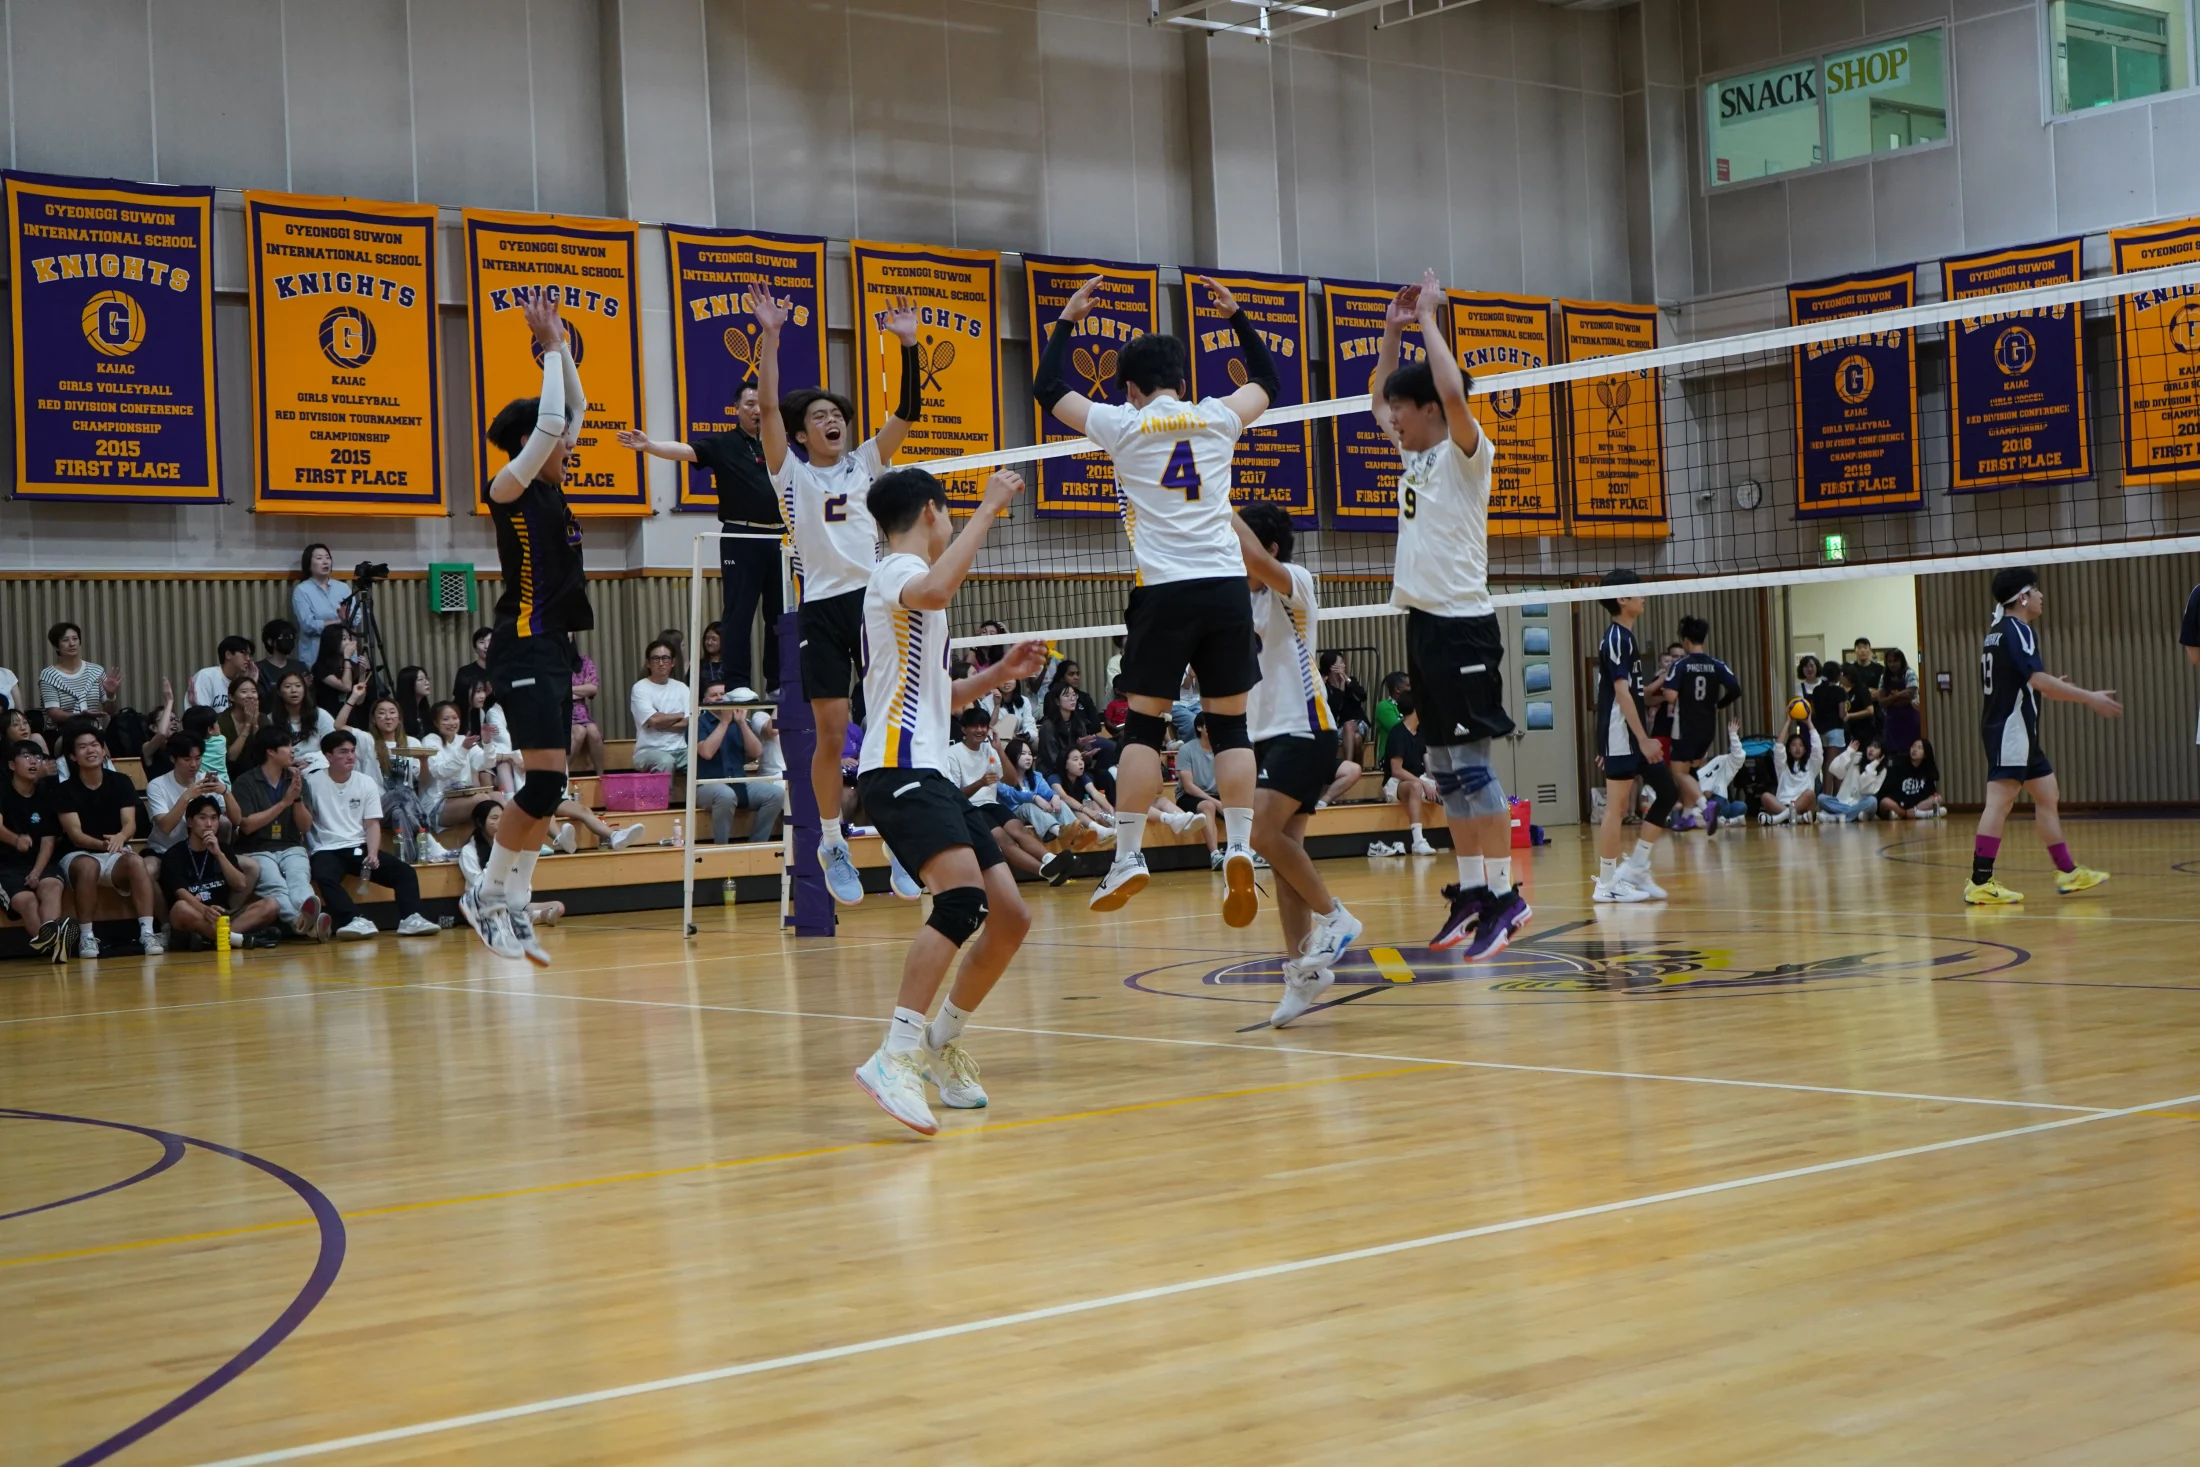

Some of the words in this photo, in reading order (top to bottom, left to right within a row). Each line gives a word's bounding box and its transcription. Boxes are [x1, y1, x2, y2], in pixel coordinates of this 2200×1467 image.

[1721, 69, 1816, 119] SNACK
[1827, 47, 1908, 94] SHOP
[45, 204, 117, 220] GYEONGGI
[121, 210, 175, 225] SUWON
[24, 224, 141, 245] INTERNATIONAL
[145, 234, 196, 248] SCHOOL
[286, 224, 350, 239] GYEONGGI
[354, 230, 402, 244] SUWON
[266, 243, 372, 263] INTERNATIONAL
[375, 254, 422, 266] SCHOOL
[499, 240, 558, 253] GYEONGGI
[561, 245, 606, 257] SUWON
[2141, 243, 2193, 259] GYEONGGI
[699, 252, 753, 264] GYEONGGI
[756, 254, 797, 269] SUWON
[32, 254, 190, 292] KNIGHTS
[482, 259, 579, 276] INTERNATIONAL
[581, 267, 624, 278] SCHOOL
[882, 266, 932, 278] GYEONGGI
[934, 270, 971, 283] SUWON
[1969, 265, 2016, 283] GYEONGGI
[2018, 260, 2055, 274] SUWON
[683, 269, 772, 286] INTERNATIONAL
[774, 277, 813, 288] SCHOOL
[274, 272, 416, 308] KNIGHTS
[867, 283, 948, 299] INTERNATIONAL
[951, 290, 986, 301] SCHOOL
[1100, 281, 1134, 294] SUWON
[1957, 281, 2032, 299] INTERNATIONAL
[2035, 274, 2070, 288] SCHOOL
[1208, 291, 1250, 302] GYNGGI
[1252, 293, 1284, 306] SUWON
[1812, 295, 1855, 311] GYEONGGI
[1856, 290, 1891, 304] SUWON
[689, 293, 809, 327] KNIGTS
[1115, 301, 1148, 312] SCHOOL
[1346, 301, 1386, 313] GYEONGGI
[98, 301, 130, 345] G
[874, 306, 982, 338] KGHTS
[1267, 312, 1297, 323] SCHOOL
[1468, 312, 1505, 322] GYEONGGI
[1506, 313, 1533, 325] SUWON
[1458, 327, 1517, 339] INTERNATIONAL
[1519, 331, 1544, 341] SCHOOL
[1580, 320, 1613, 330] GYEONGGI
[1616, 322, 1640, 333] SUWON
[333, 317, 363, 359] G
[1571, 336, 1625, 348] INTERNATIONAL
[1627, 339, 1651, 349] SCHOOL
[1464, 346, 1542, 369] KNIGHTS
[97, 363, 135, 374] KAIAC
[59, 381, 93, 392] GIRLS
[97, 383, 173, 396] VOLLEYBALL
[331, 376, 366, 386] KAIAC
[2004, 380, 2029, 390] KAIAC
[2164, 380, 2188, 392] GIRLS
[38, 399, 61, 410] RED
[64, 401, 117, 412] DIVISION
[120, 403, 194, 415] CONFERENCE
[297, 393, 328, 403] GIRLS
[331, 394, 400, 406] VOLLEYBALL
[2134, 400, 2150, 409] RED
[2152, 395, 2191, 407] DIVISION
[275, 410, 296, 420] RED
[299, 412, 346, 423] DIVISION
[349, 414, 422, 426] TOURNAMENT
[932, 415, 961, 424] TENNIS
[1844, 408, 1867, 417] KAIAC
[1983, 411, 2017, 423] DIVISION
[72, 421, 161, 434] CHAMPIONSHIP
[692, 422, 711, 432] RED
[1141, 412, 1207, 434] KNIGHTS
[1822, 425, 1842, 434] GIRLS
[2178, 423, 2200, 437] 201
[310, 431, 390, 443] CHAMPIONSHIP
[931, 431, 989, 441] TOURNAMENT
[96, 440, 141, 456] 2015
[901, 446, 964, 456] CHAMPIONSHIP
[2002, 437, 2032, 453] 2018
[2152, 444, 2191, 459] FIRST
[330, 449, 371, 465] 2015
[1508, 453, 1549, 461] TOURNAMENT
[1978, 457, 2015, 473] FIRST
[2020, 452, 2062, 469] PLACE
[55, 460, 112, 477] FIRST
[118, 462, 180, 479] PLACE
[295, 468, 346, 484] FIRST
[351, 470, 408, 486] PLACE
[1158, 439, 1202, 502] 4
[564, 473, 615, 488] PLACE
[1240, 471, 1266, 484] 2017
[1498, 479, 1520, 490] 2017
[942, 480, 977, 494] LACE
[1062, 482, 1098, 496] FIRST
[1608, 483, 1629, 494] 2017
[1821, 481, 1854, 495] FIRST
[1859, 477, 1896, 491] PLACE
[1254, 488, 1291, 501] PLACE
[1356, 490, 1386, 503] FIRST
[1511, 496, 1541, 508] PLACE
[824, 491, 847, 522] 2
[1404, 487, 1416, 519] 9
[1591, 498, 1616, 509] FIRST
[1620, 498, 1649, 510] PLACE
[1687, 663, 1715, 673] PHOENIX
[1695, 676, 1706, 701] 8
